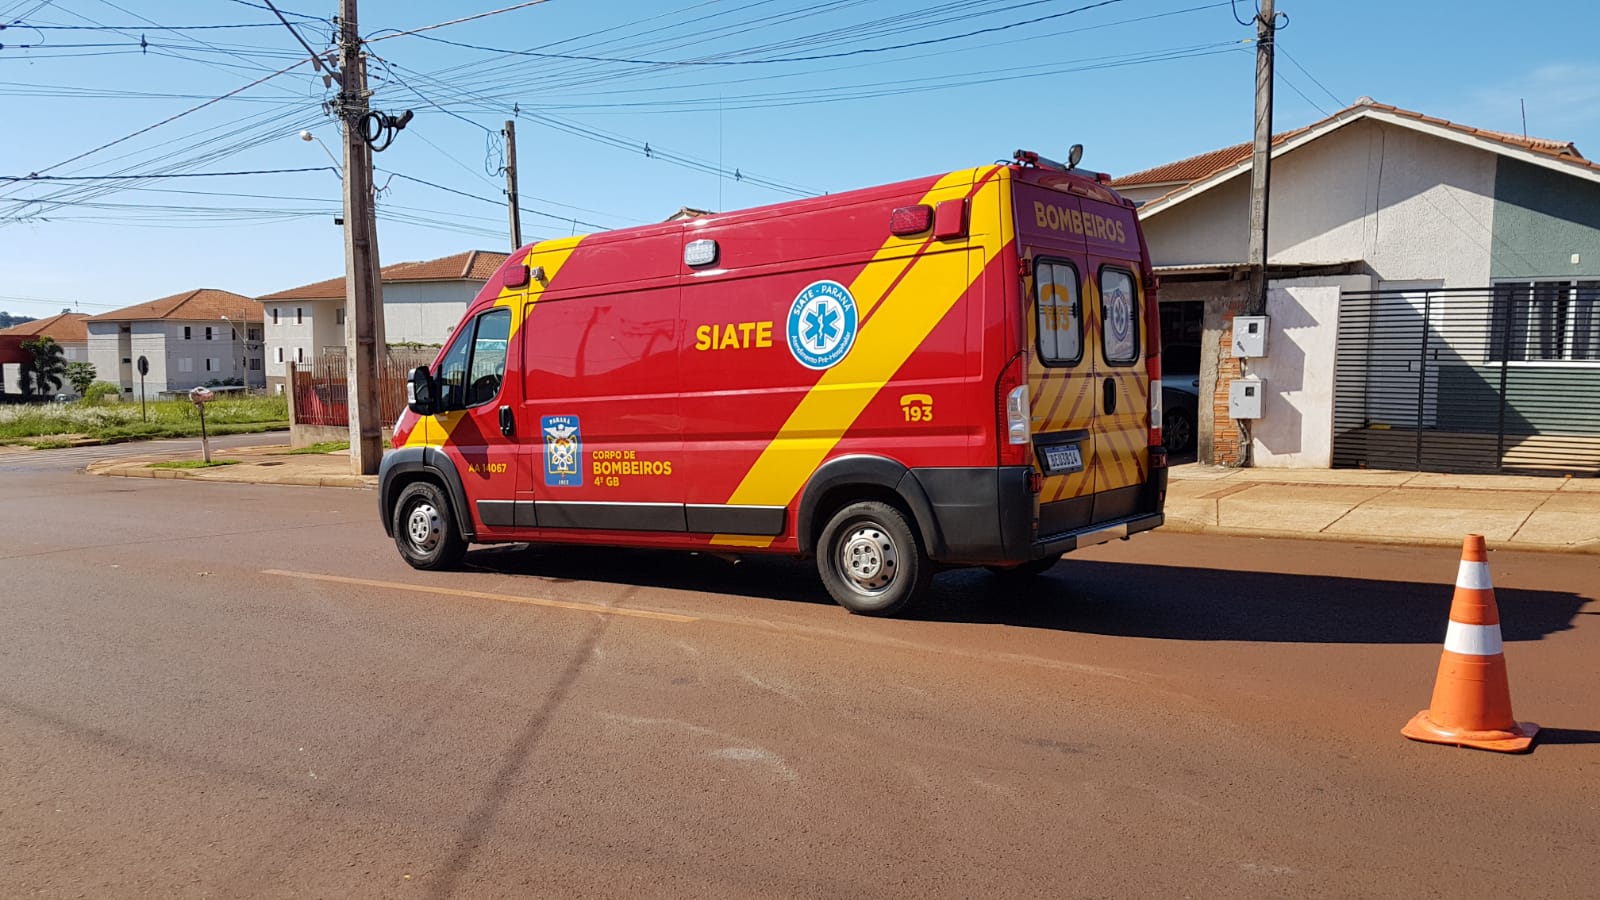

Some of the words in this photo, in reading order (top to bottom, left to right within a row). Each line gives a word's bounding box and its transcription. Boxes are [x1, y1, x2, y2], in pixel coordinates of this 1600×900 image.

[1034, 201, 1126, 244] BOMBEIROS
[793, 289, 814, 316] SIATE
[695, 321, 774, 351] SIATE
[902, 406, 933, 422] 193
[592, 450, 622, 460] CORPO
[623, 450, 636, 460] DE
[468, 463, 481, 473] AA
[482, 463, 507, 473] 14067
[592, 461, 672, 475] BOMBEIROS
[606, 476, 620, 487] GB
